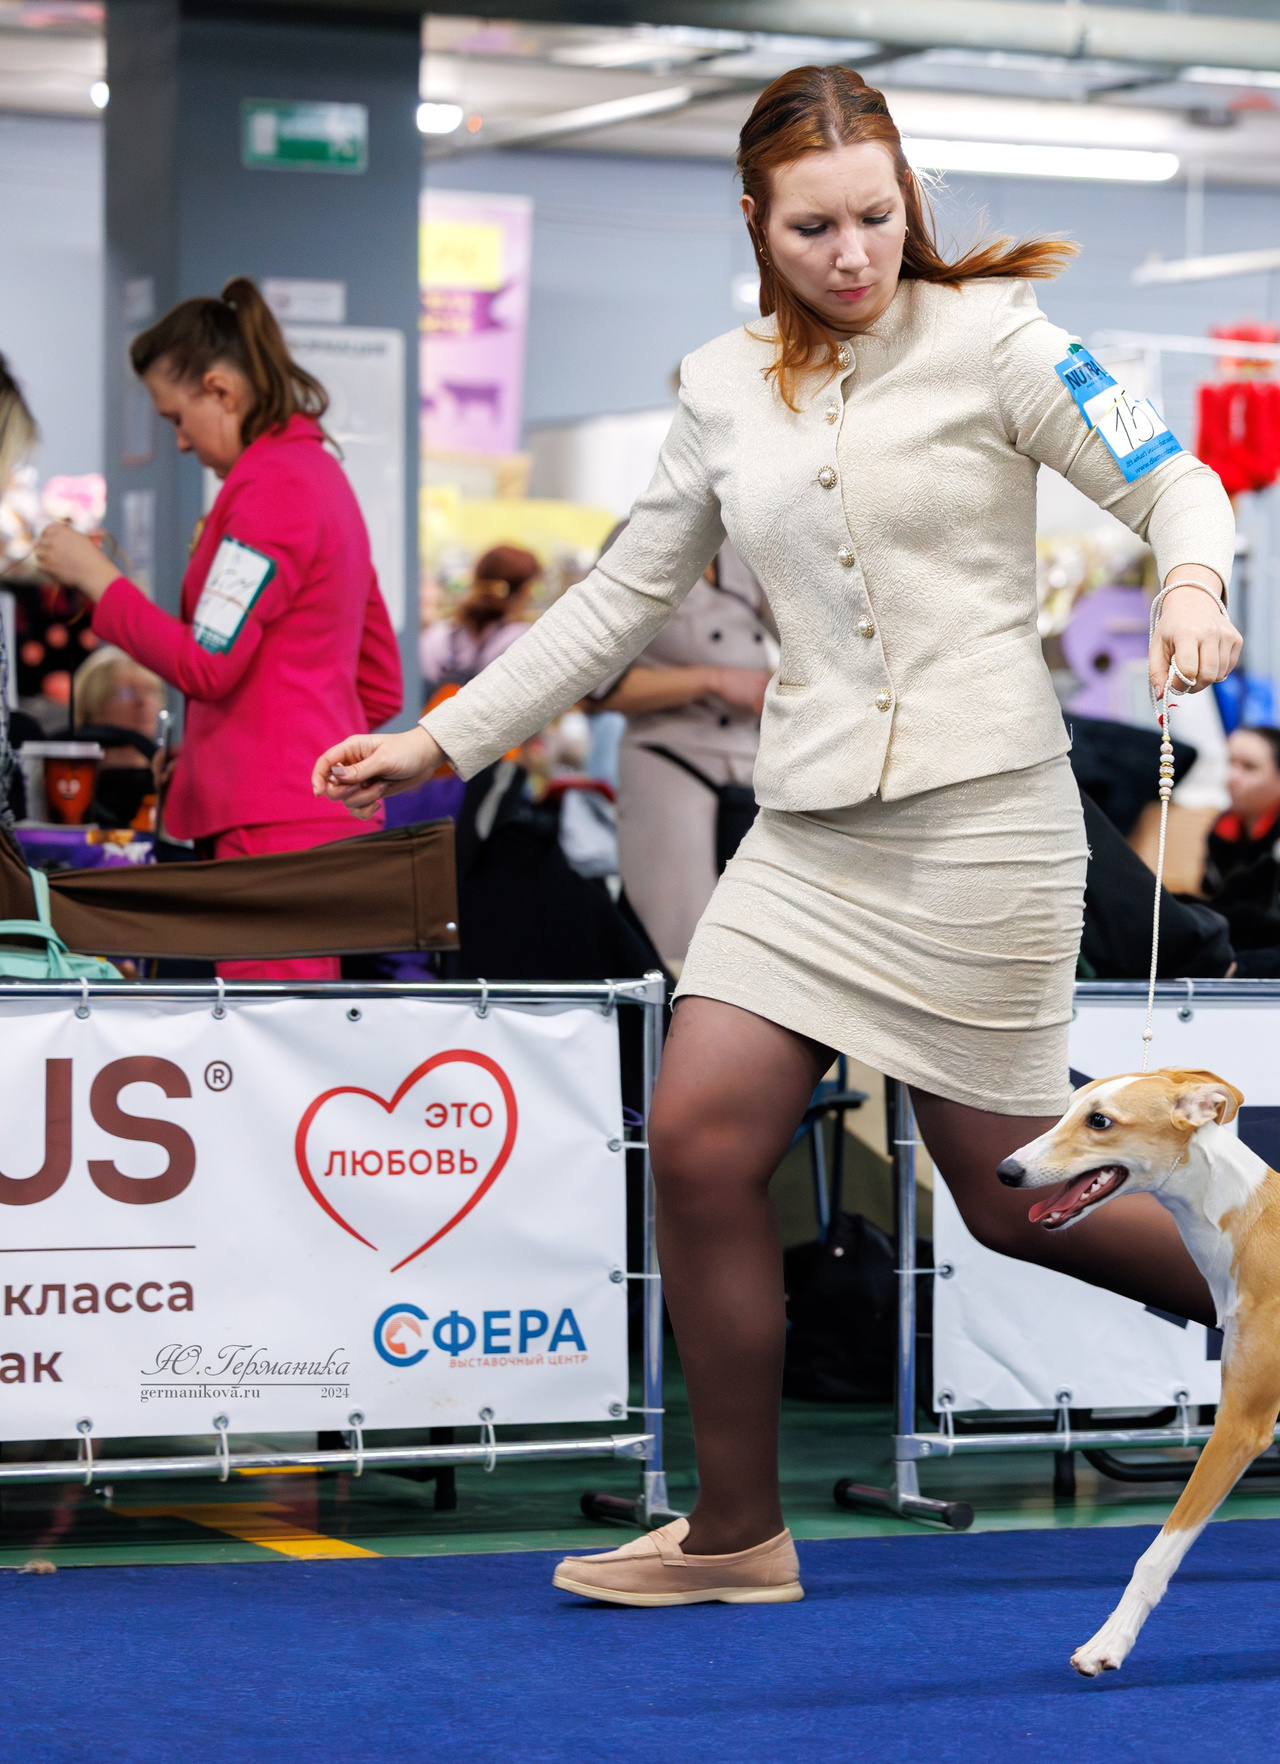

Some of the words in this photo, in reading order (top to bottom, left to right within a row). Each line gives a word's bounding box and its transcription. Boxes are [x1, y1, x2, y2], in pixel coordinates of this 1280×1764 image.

[425, 1102, 493, 1128] ЭТО
[324, 1149, 478, 1176] ЛЮБОВЬ
[4, 1281, 194, 1316] класса
[373, 1303, 587, 1367] СФЕРА
[449, 1354, 544, 1368] ВЫСТАВОЧНЫЙ
[548, 1354, 588, 1366] ЦЕНТР
